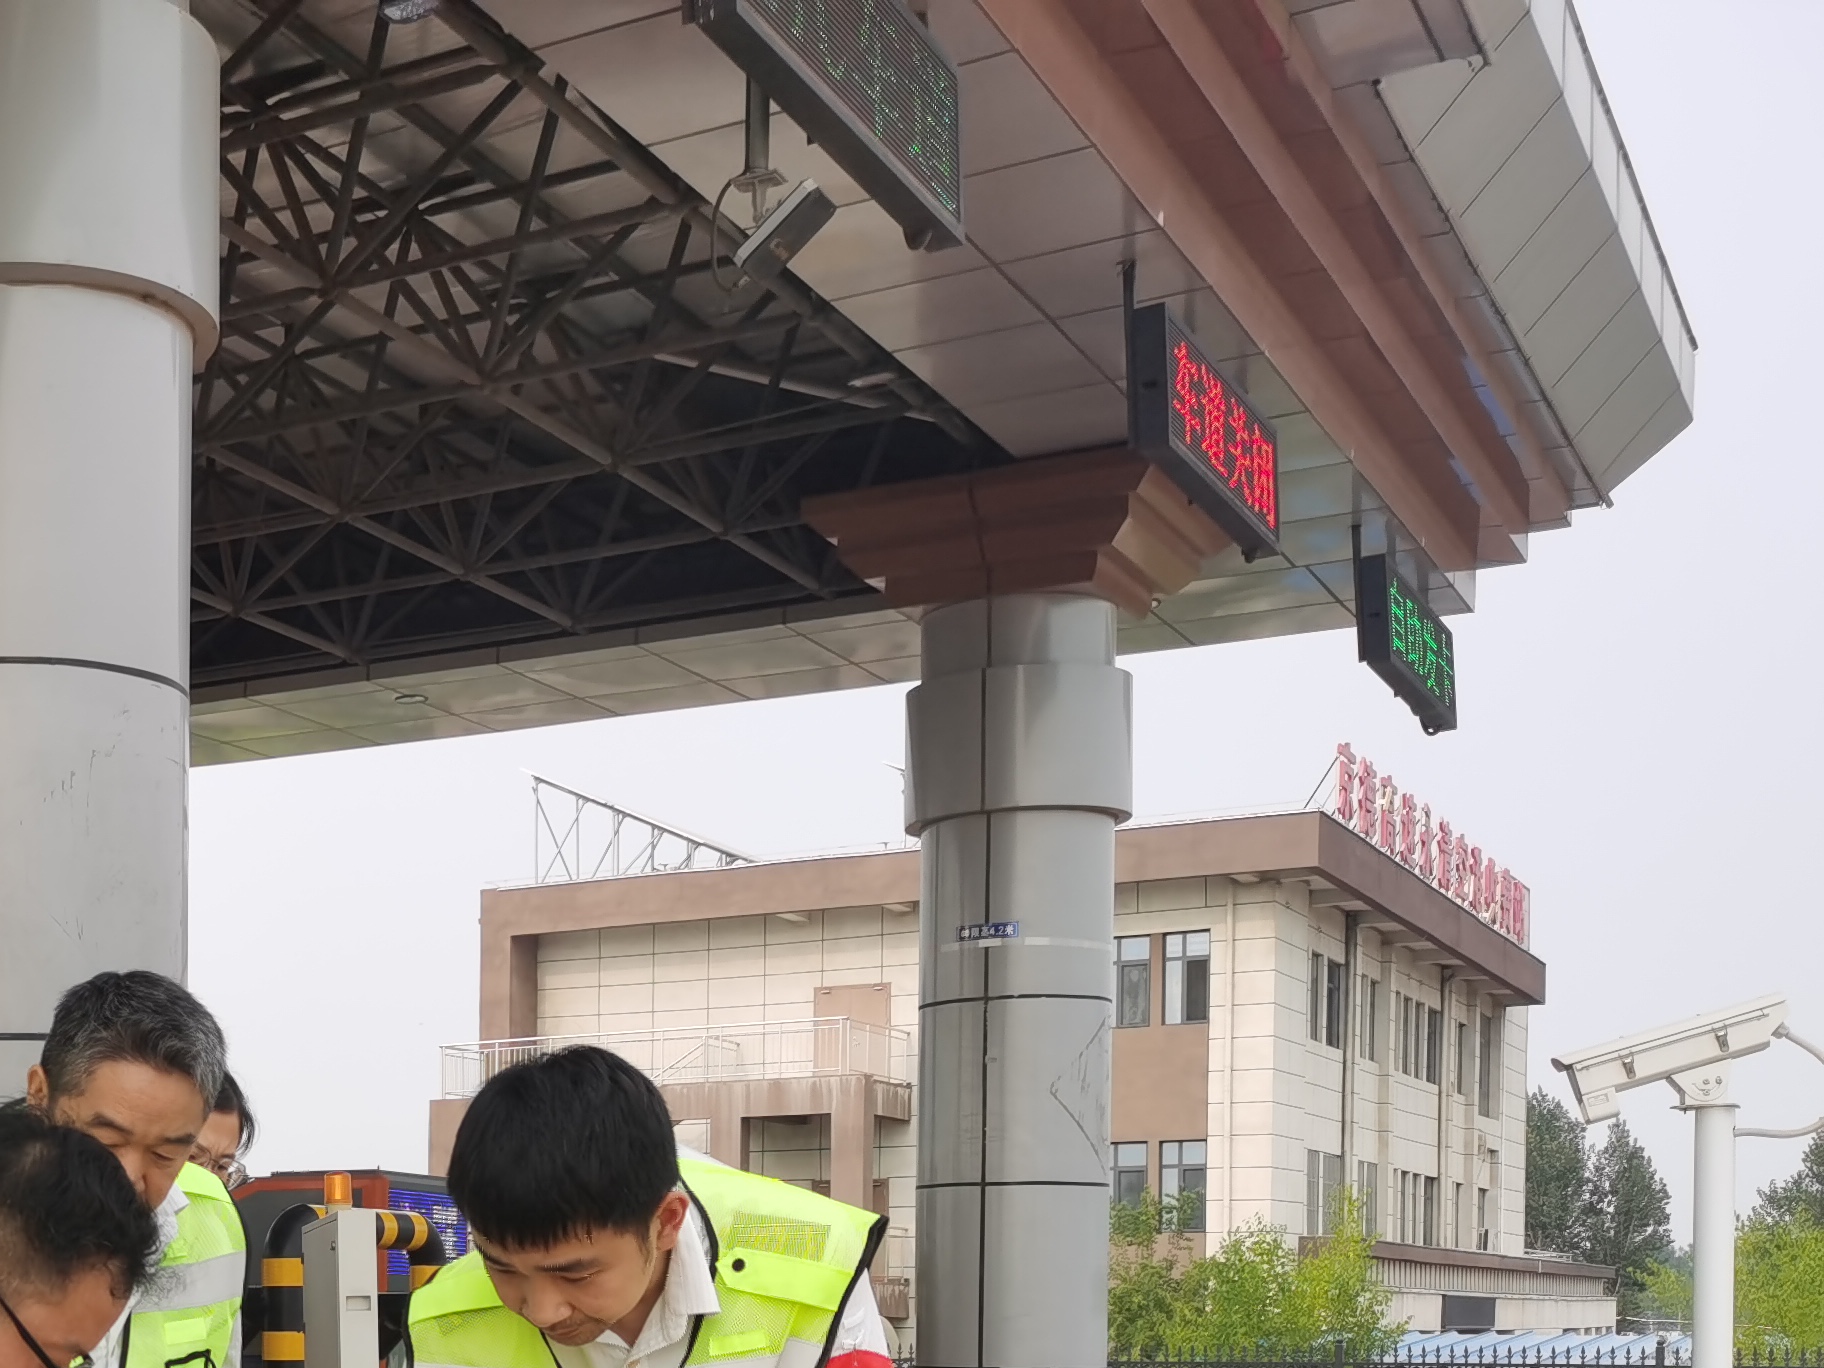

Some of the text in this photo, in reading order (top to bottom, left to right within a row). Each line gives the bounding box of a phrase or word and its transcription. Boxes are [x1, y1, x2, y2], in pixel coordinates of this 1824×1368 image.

[1173, 341, 1276, 529] 车道关闭
[1390, 577, 1453, 707] 自助发卡
[971, 924, 1015, 938] 限高4.2米
